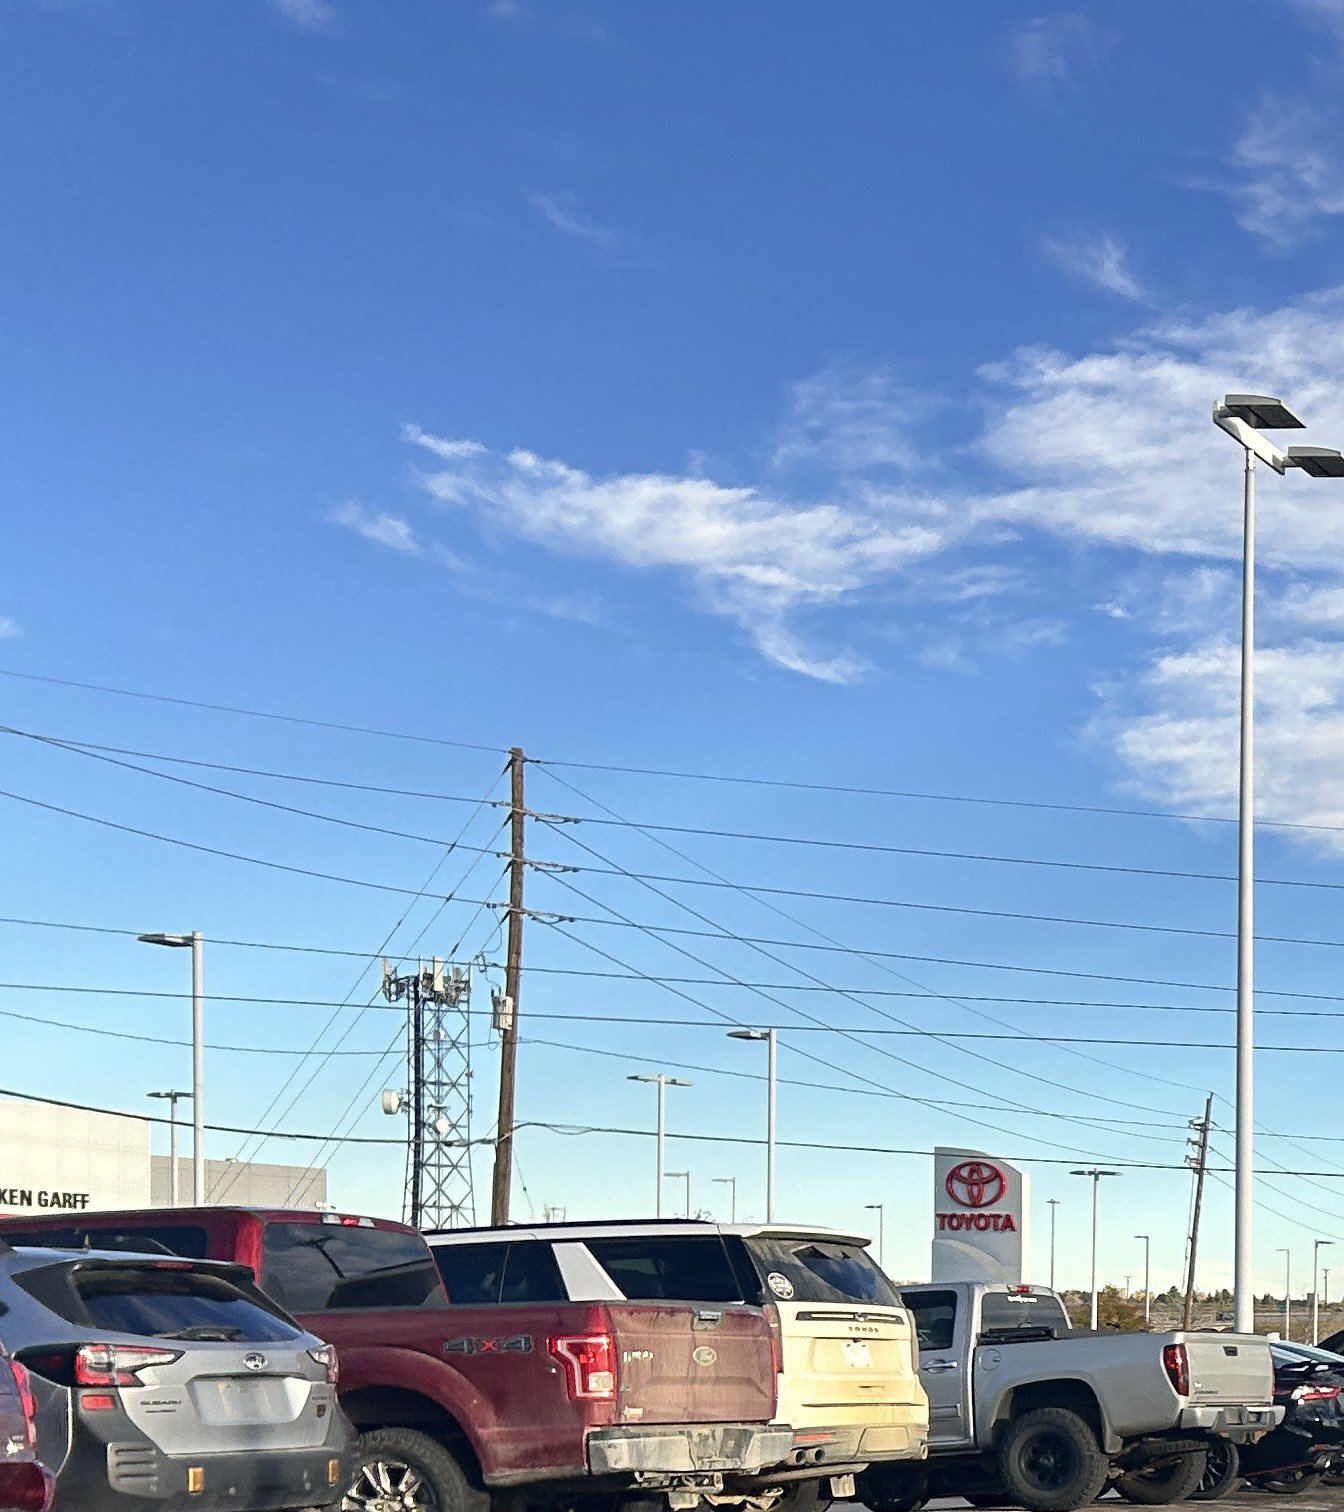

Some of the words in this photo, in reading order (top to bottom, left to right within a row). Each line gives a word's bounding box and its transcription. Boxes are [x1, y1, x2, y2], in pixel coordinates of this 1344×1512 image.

[0, 1188, 32, 1206] KEN
[37, 1190, 90, 1209] GARFF
[935, 1213, 1017, 1232] TOYOTA
